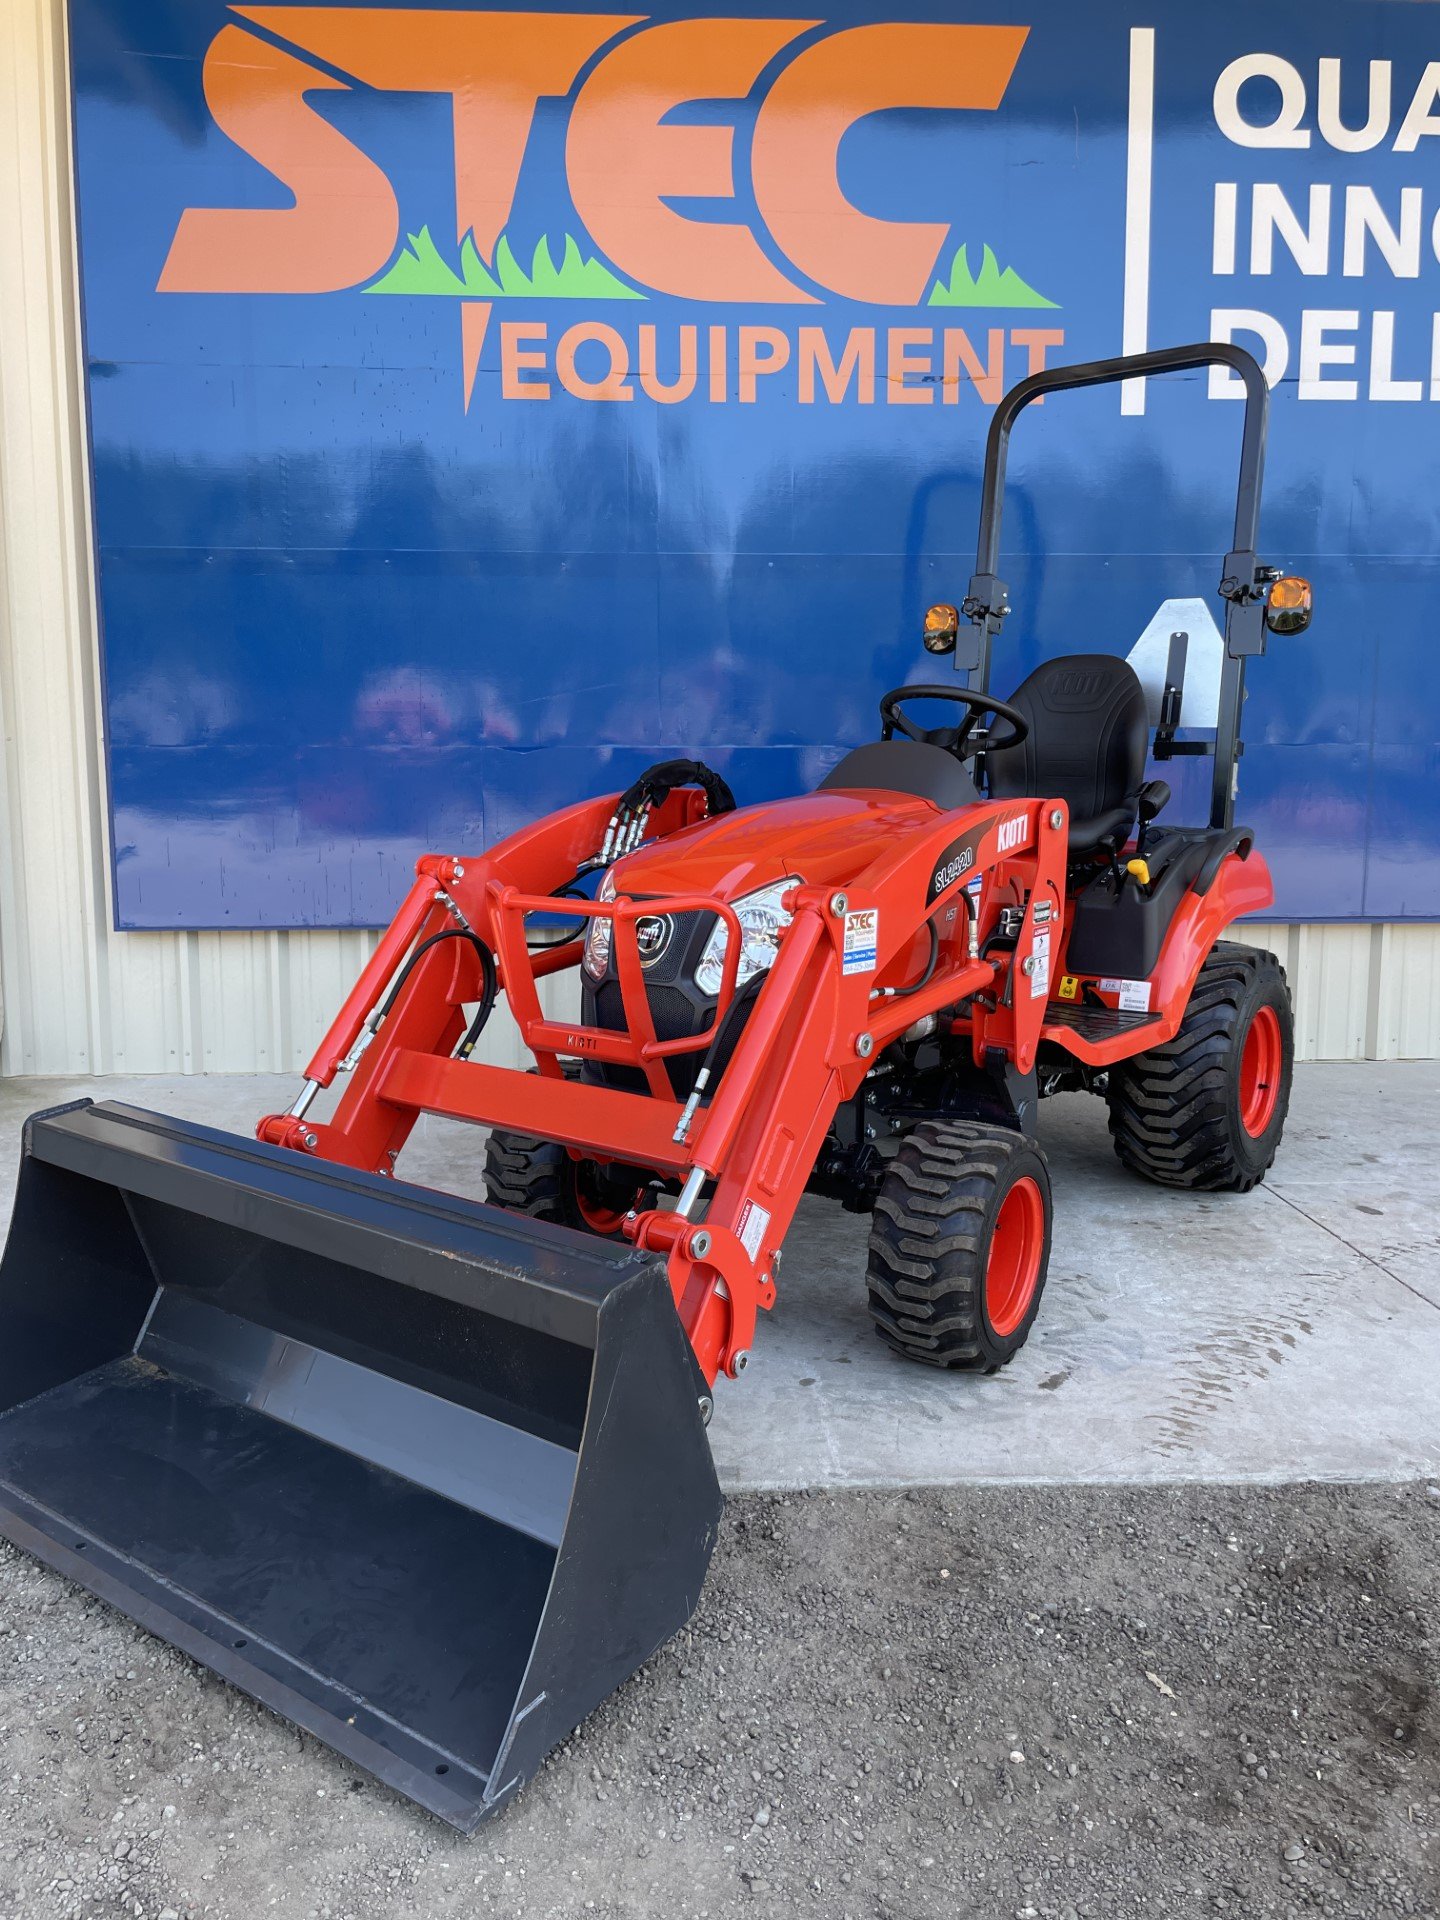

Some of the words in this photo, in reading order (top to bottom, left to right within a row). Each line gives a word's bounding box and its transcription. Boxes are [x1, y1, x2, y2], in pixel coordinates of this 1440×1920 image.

[156, 5, 1031, 306] STEC
[1213, 183, 1440, 278] INN
[501, 321, 1064, 405] EQUIPMENT
[997, 814, 1028, 853] KIOTI
[935, 846, 972, 892] SL2420
[847, 912, 875, 931] STEC
[735, 1204, 751, 1238] DANGER
